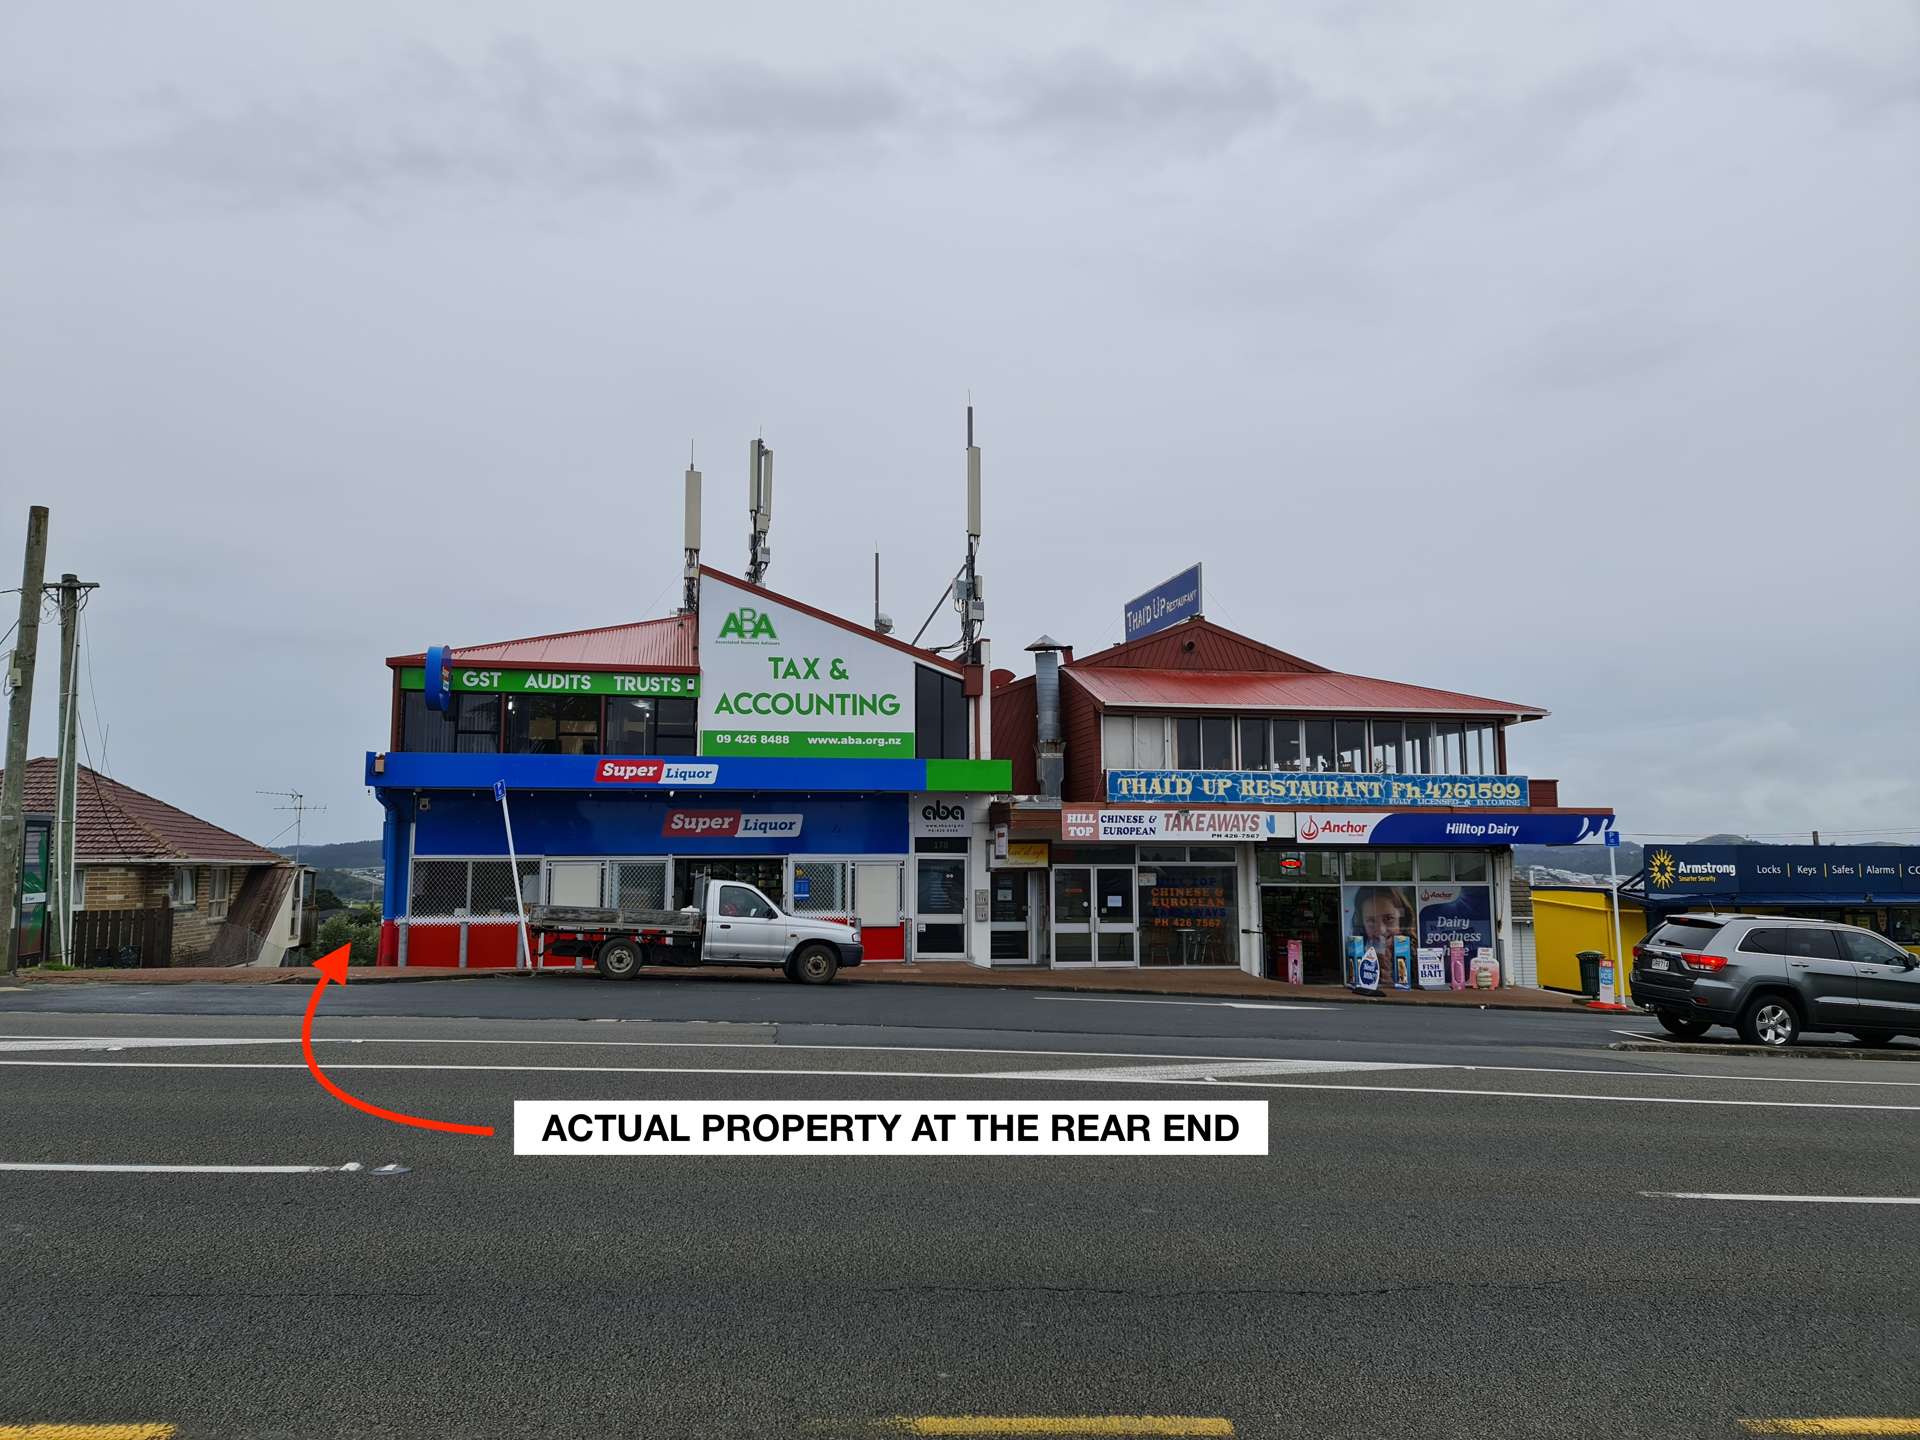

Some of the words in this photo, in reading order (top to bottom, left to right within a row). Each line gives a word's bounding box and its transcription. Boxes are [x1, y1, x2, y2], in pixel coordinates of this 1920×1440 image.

[1153, 596, 1166, 619] UP
[1166, 589, 1198, 613] RESTAURANT
[719, 608, 777, 640] ABA
[768, 656, 820, 680] TAX
[829, 658, 849, 681] &
[462, 671, 502, 688] GST
[524, 673, 592, 690] AUDITS
[614, 675, 682, 692] TRUSTS
[714, 691, 902, 718] ACCOUNTING
[716, 734, 731, 744] 09
[735, 735, 757, 744] 426
[761, 735, 790, 744] 8488
[807, 736, 901, 747] www.aba.org.nz
[602, 763, 658, 780] Super
[665, 768, 712, 781] Liquor
[1117, 774, 1193, 796] THAI'D
[1203, 779, 1233, 797] UP
[1240, 779, 1383, 799] RESTAURANT
[922, 800, 965, 821] aba
[671, 813, 734, 832] Super
[743, 819, 796, 834] Liquor
[1065, 813, 1097, 824] HILL
[1100, 815, 1145, 824] CHINESE
[1148, 815, 1158, 824] &
[1163, 812, 1261, 833] TAKEAWAYS
[1068, 826, 1094, 837] TOP
[1103, 826, 1157, 836] EUROPEAN
[1320, 820, 1368, 833] Anchor
[1446, 823, 1487, 837] Hilltop
[1488, 823, 1520, 837] Dairy
[1678, 861, 1737, 877] Armstrong
[1757, 864, 1782, 875] Locks
[1797, 864, 1818, 877] Keys
[1831, 864, 1855, 875] Safes
[1866, 865, 1895, 875] Alarms
[1679, 875, 1698, 883] Smarter
[1698, 875, 1717, 884] Security
[1151, 887, 1211, 897] CHINESE
[1154, 919, 1169, 927] PH
[1174, 919, 1193, 928] 426
[1436, 915, 1470, 930] Dairy
[1426, 930, 1482, 945] goodness
[1420, 969, 1443, 978] BAIT
[1422, 963, 1441, 971] FISH
